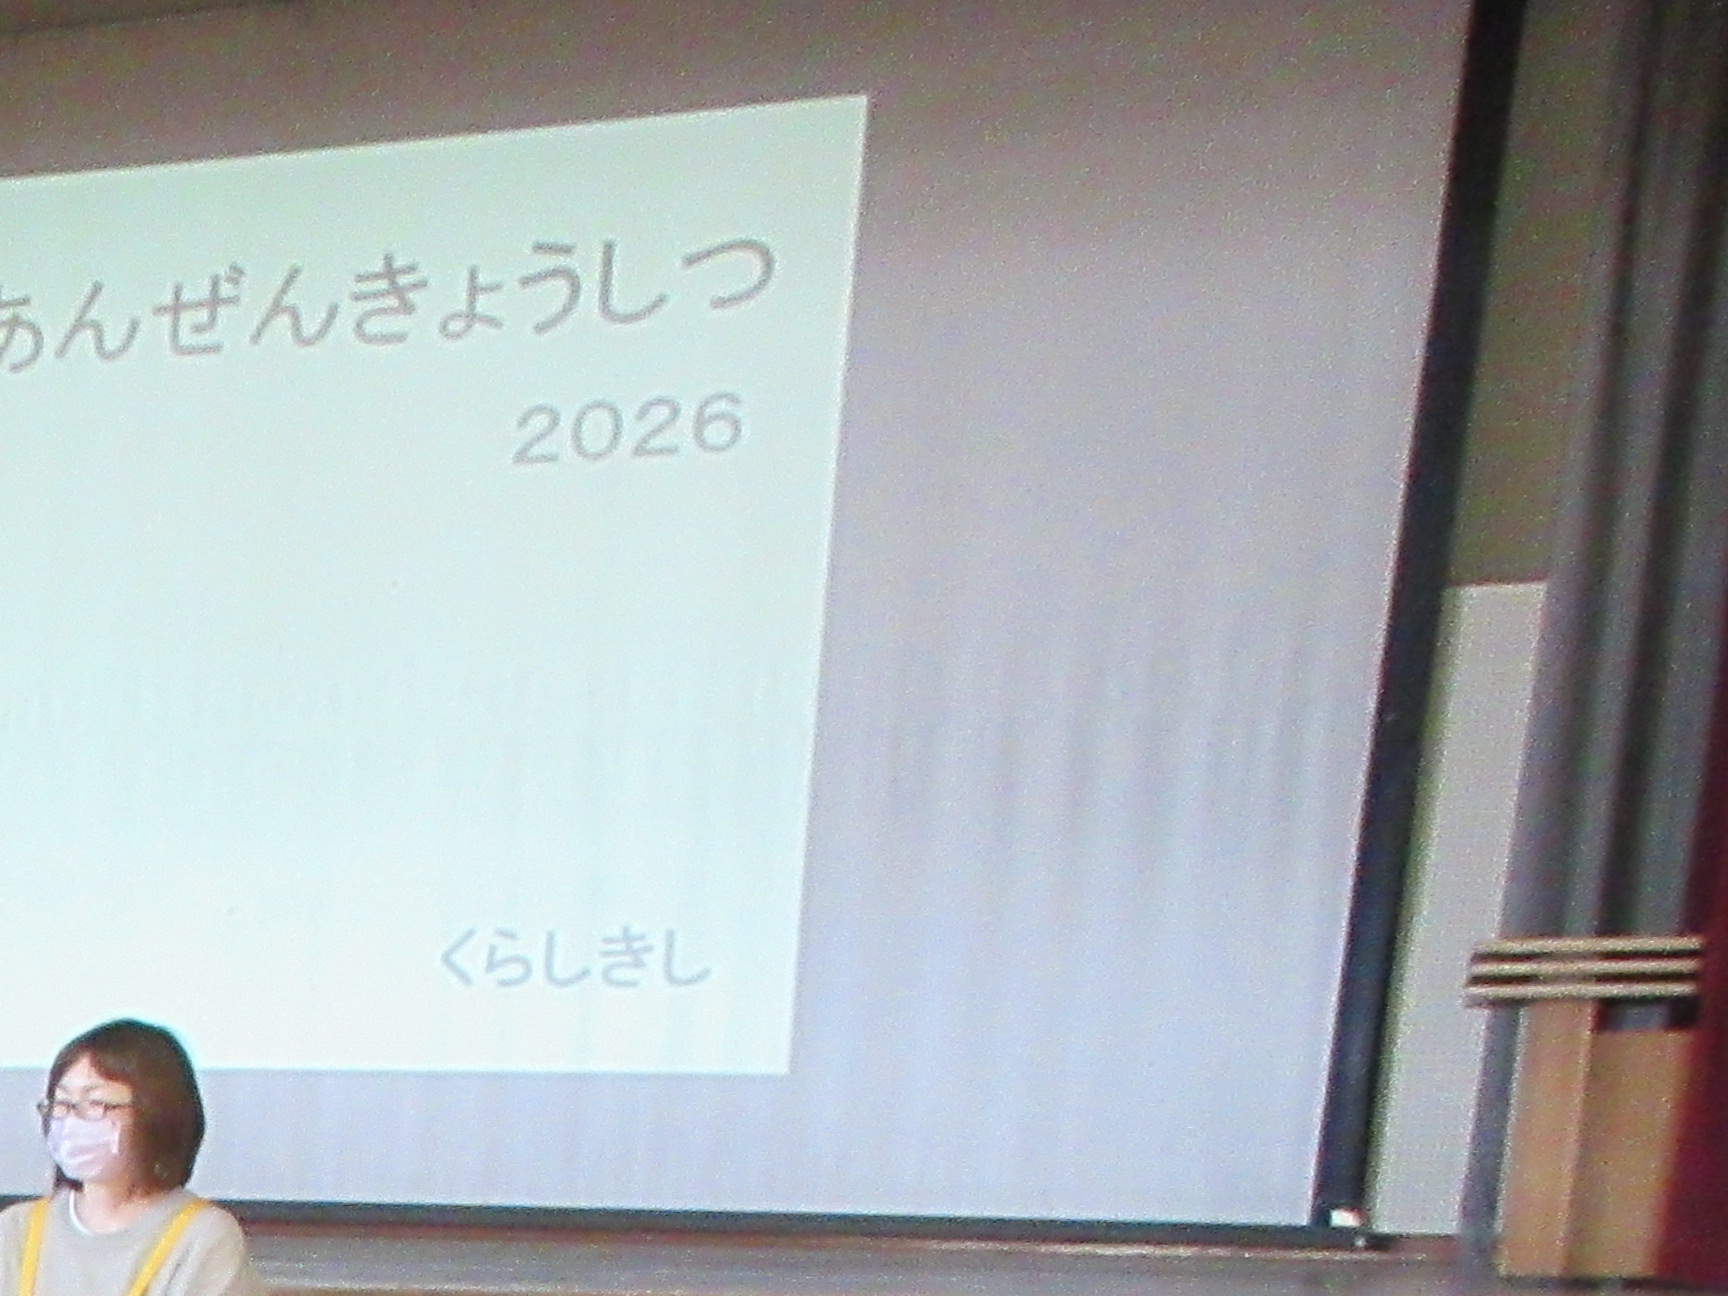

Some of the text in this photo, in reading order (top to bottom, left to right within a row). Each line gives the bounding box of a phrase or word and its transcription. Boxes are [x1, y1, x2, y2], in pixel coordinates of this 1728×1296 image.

[511, 391, 744, 467] 2026
[440, 923, 713, 988] くらしきし
